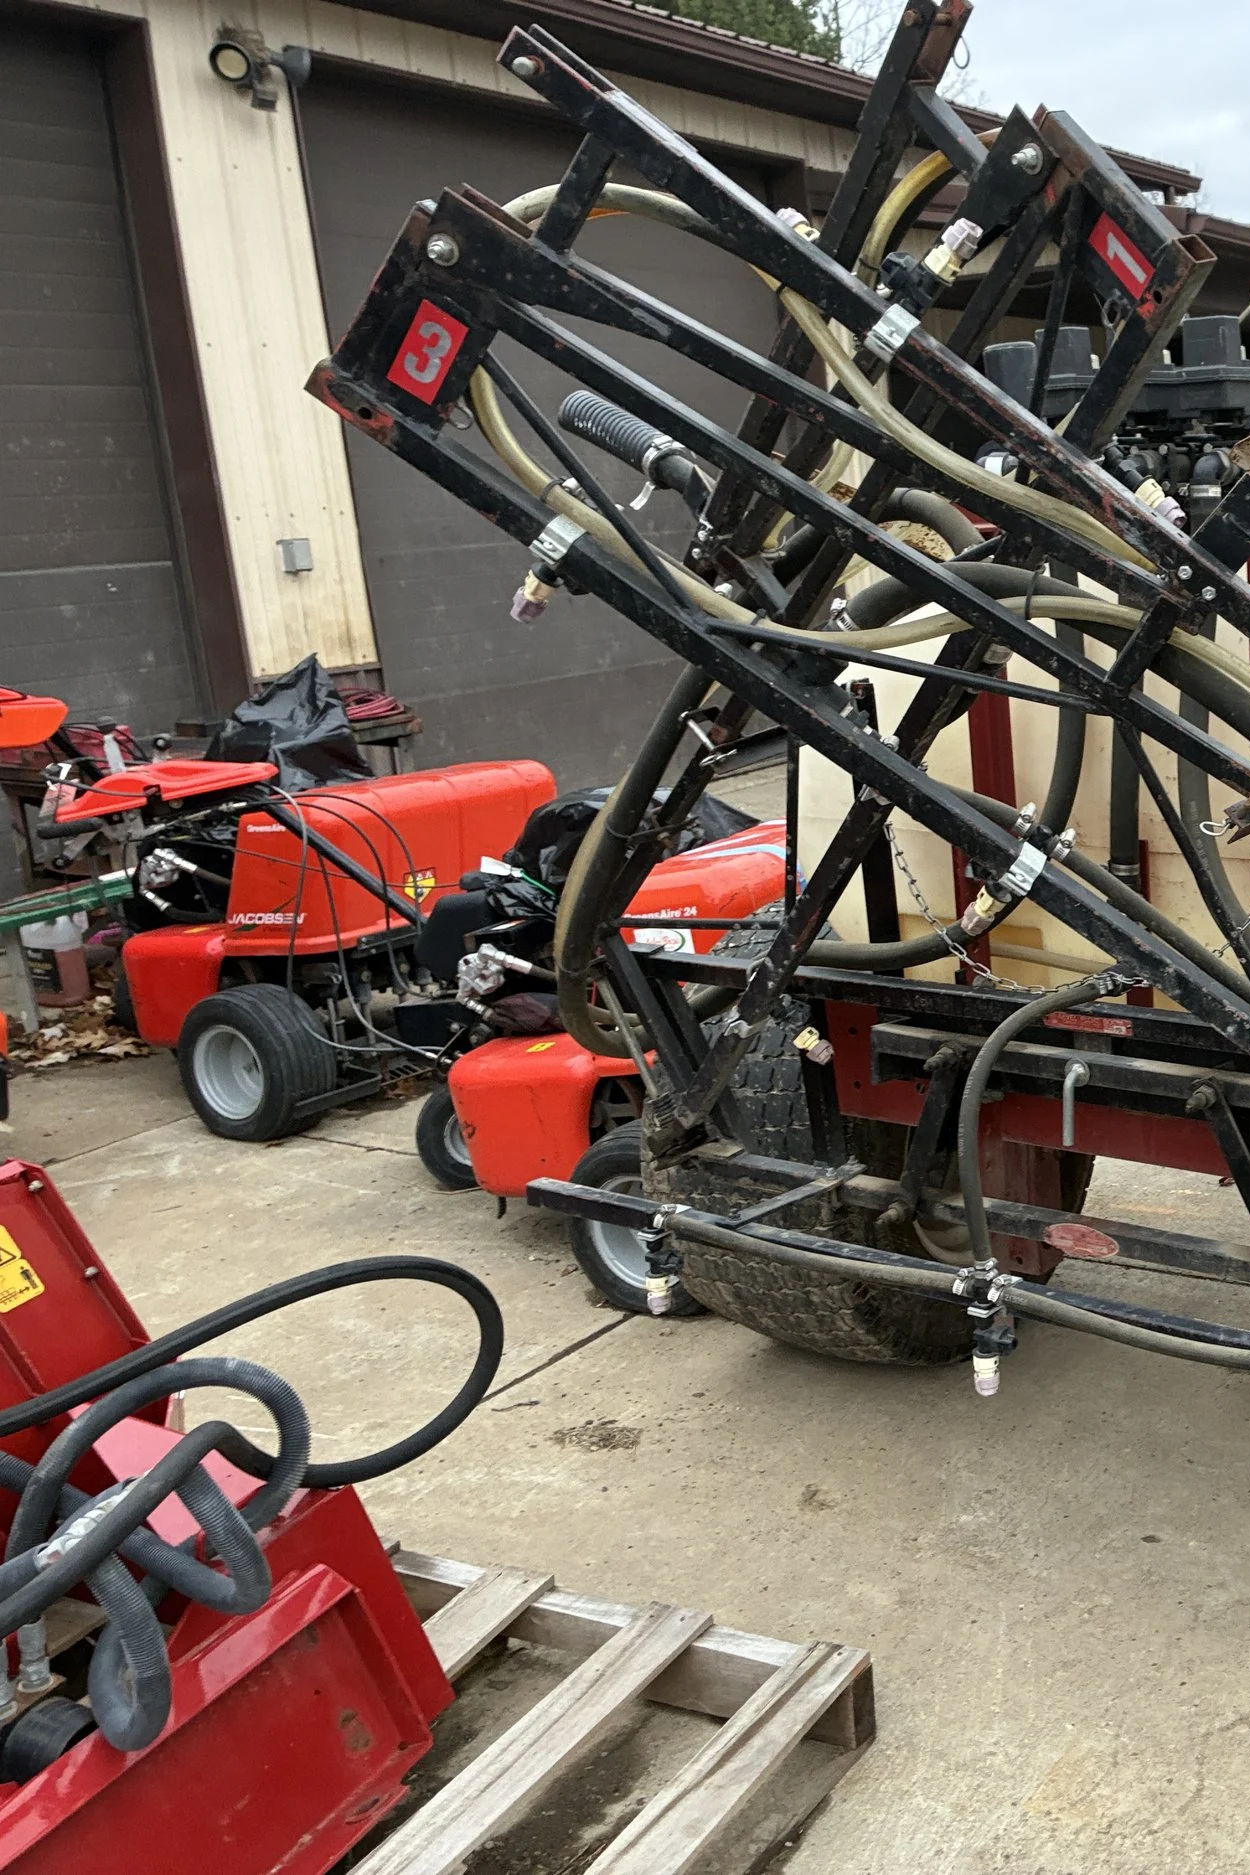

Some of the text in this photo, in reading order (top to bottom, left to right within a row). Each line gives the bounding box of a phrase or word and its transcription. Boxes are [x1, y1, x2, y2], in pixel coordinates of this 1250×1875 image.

[1106, 231, 1148, 284] 1
[404, 321, 452, 384] 3
[228, 912, 308, 925] JACOBSEN
[683, 905, 698, 917] 24
